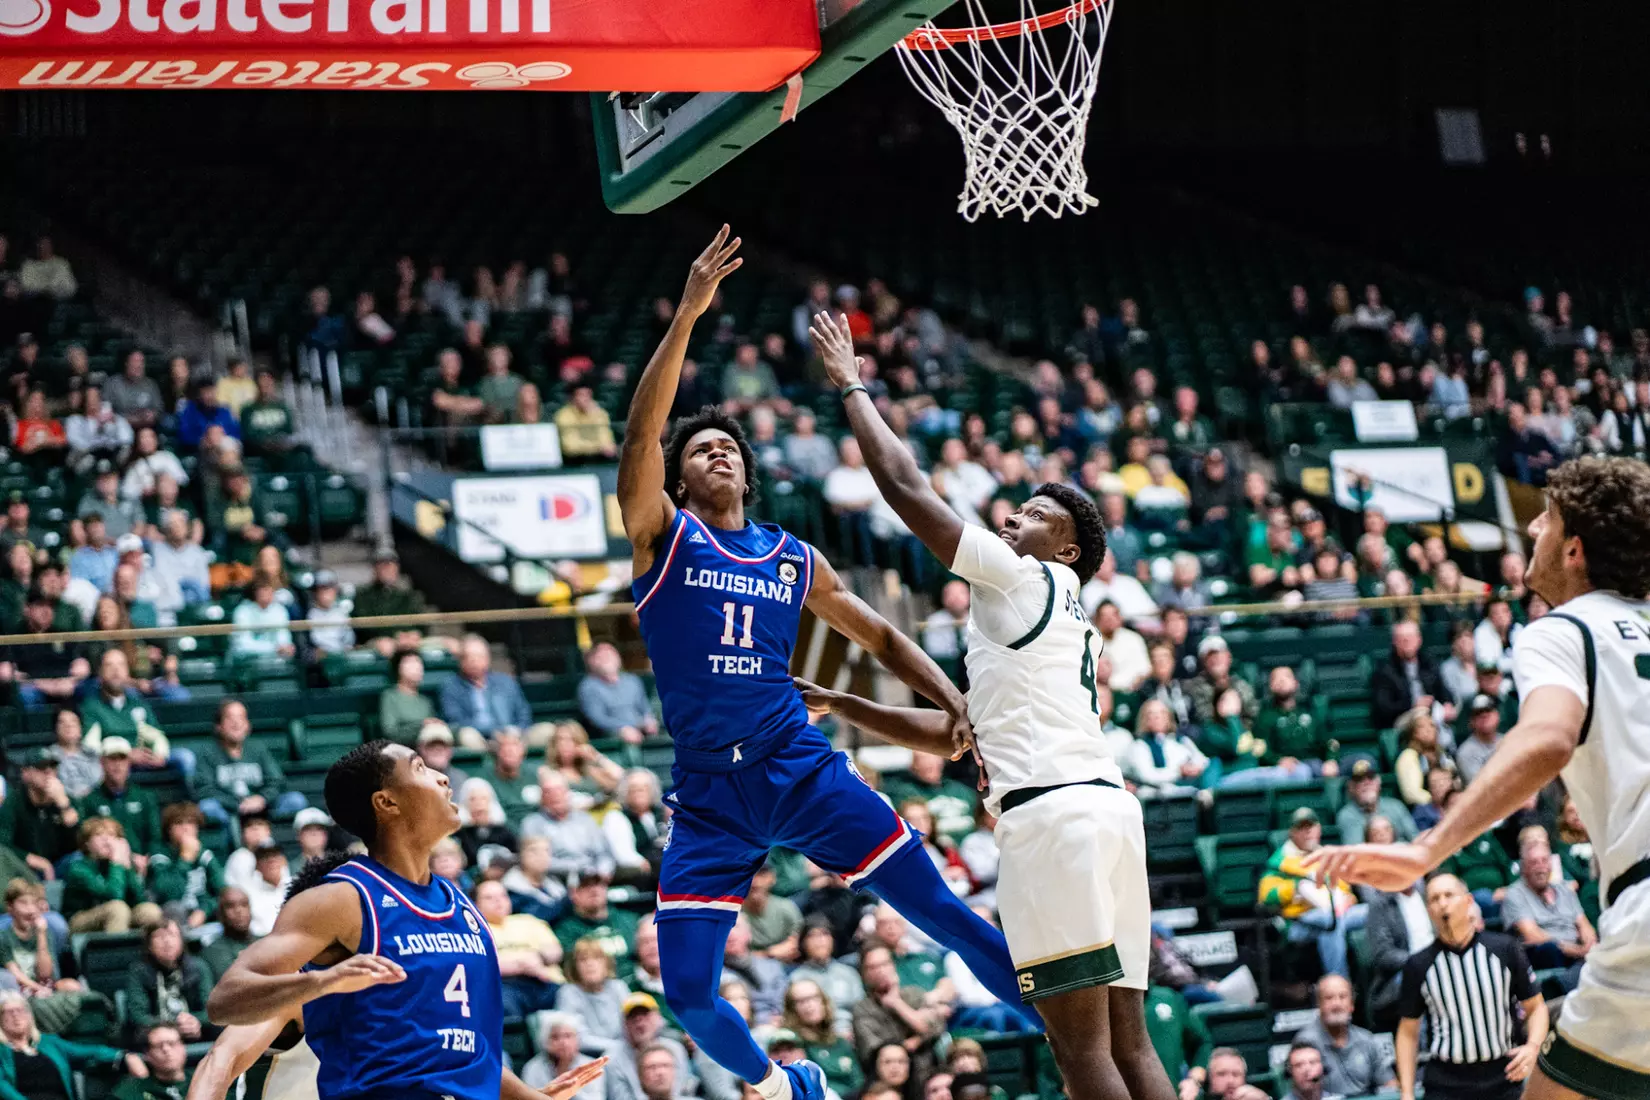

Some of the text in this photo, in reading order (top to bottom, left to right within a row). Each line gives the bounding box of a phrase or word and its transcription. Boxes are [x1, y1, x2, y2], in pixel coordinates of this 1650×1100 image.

[18, 60, 452, 89] StateFarm
[685, 567, 791, 604] LOUISIANA
[720, 602, 754, 648] 11
[708, 654, 762, 675] TECH
[1080, 628, 1099, 715] 4
[394, 933, 486, 956] LOUISIANA
[443, 964, 471, 1017] 4
[436, 1028, 476, 1053] TECH
